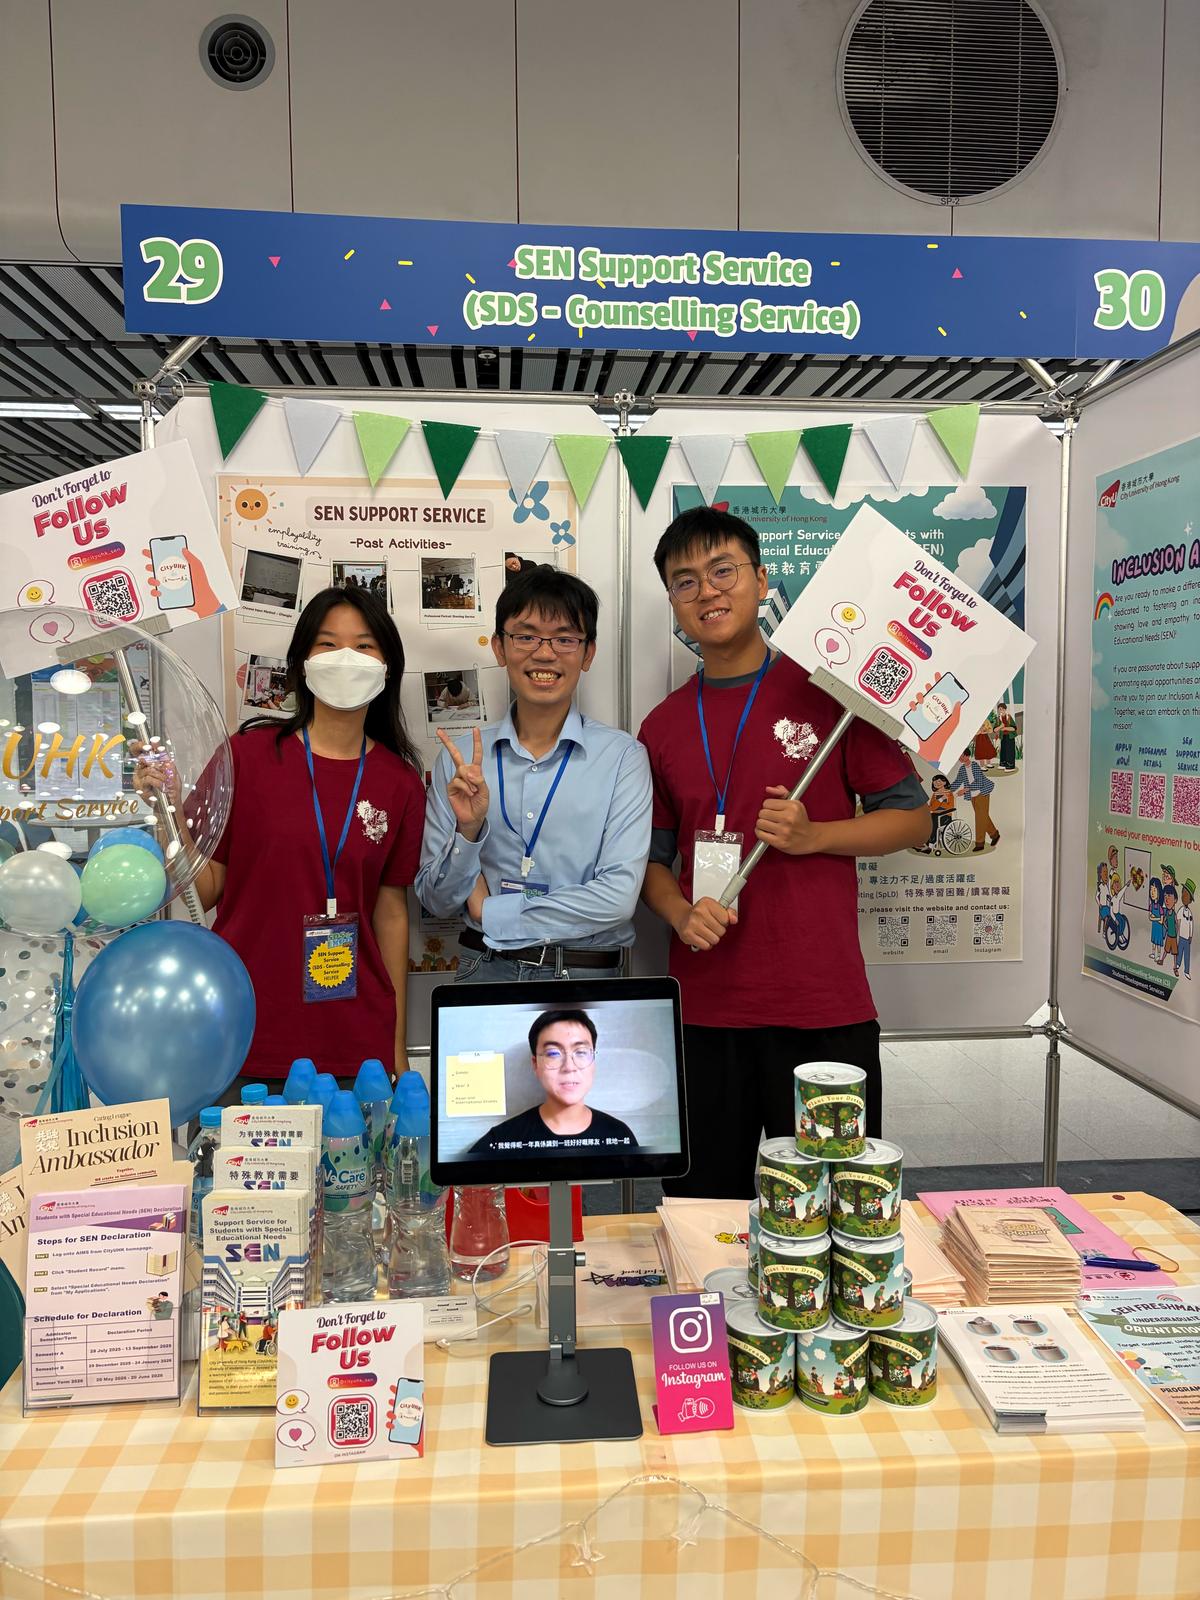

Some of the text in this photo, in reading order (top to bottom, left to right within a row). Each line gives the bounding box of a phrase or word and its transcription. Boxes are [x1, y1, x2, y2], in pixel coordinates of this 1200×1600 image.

[940, 196, 961, 206] SP-2
[139, 236, 224, 304] 29
[513, 244, 813, 287] SEN Support Service
[1092, 267, 1166, 331] 30
[462, 290, 538, 331] (SDS
[564, 293, 738, 337] Counselling
[740, 299, 861, 340] Service)
[31, 469, 113, 509] Don't Forget to
[1128, 486, 1150, 499] University
[33, 481, 129, 538] Follow
[313, 505, 487, 524] SEN SUPPORT SERVICE
[732, 505, 788, 515] 香港城市大學
[747, 514, 828, 525] University of Hong Kong
[72, 518, 111, 546] Us
[268, 527, 323, 547] employability
[796, 529, 841, 541] Service
[920, 528, 945, 540] with
[276, 540, 310, 556] training
[1111, 543, 1187, 586] INCLUSION
[913, 559, 979, 609] Don't Forget to
[892, 571, 978, 632] Follow
[1124, 586, 1176, 603] you ready make
[1113, 600, 1177, 617] dedicated fostering
[908, 606, 942, 637] Us
[1113, 614, 1190, 632] showing love and empathy
[1113, 632, 1161, 646] Educational Needs
[1117, 660, 1184, 674] you are passionate about
[1112, 677, 1194, 690] promoting equal opportunities
[1113, 691, 1194, 703] invite you join our Inclusion
[1113, 707, 1190, 717] Together, can embark on
[1114, 742, 1133, 752] APPLY
[1182, 736, 1193, 746] SEN
[2, 731, 126, 781] UHK
[1138, 746, 1168, 757] PROGRAMME
[1115, 755, 1131, 767] NOW!
[1143, 759, 1162, 768] DETAILS
[1177, 762, 1199, 772] SERVICE
[55, 797, 140, 821] Service
[1104, 824, 1192, 848] We need your engagement to
[868, 873, 976, 885] 專注力不足/過度活躍症
[875, 890, 899, 900] (SpLD)
[869, 906, 894, 914] please
[894, 905, 911, 913] visit
[925, 904, 954, 912] website
[66, 1119, 159, 1148] Inclusion
[28, 1139, 160, 1176] Ambassador
[229, 1170, 300, 1181] 特殊教育需要
[338, 1169, 367, 1185] Care
[334, 1183, 360, 1191] SAFETY
[71, 1211, 91, 1219] Special
[91, 1210, 120, 1218] Educational
[121, 1208, 138, 1216] Needs
[137, 1207, 153, 1215] (SEN)
[153, 1205, 182, 1213] Declaration
[213, 1219, 244, 1227] Support
[246, 1218, 275, 1226] Service
[263, 1225, 293, 1234] Special
[37, 1231, 152, 1247] Steps for SEN Declaration
[215, 1234, 262, 1242] Educational
[225, 1243, 280, 1263] SEN
[781, 1265, 800, 1273] Your
[33, 1309, 143, 1323] Schedule for Declaration
[1111, 1306, 1135, 1316] SEN
[316, 1310, 388, 1329] Don't Forget to
[106, 1328, 136, 1336] Declaration
[310, 1324, 397, 1354] Follow
[339, 1349, 372, 1370] Us
[668, 1360, 718, 1372] FOLLOW US ON
[661, 1370, 727, 1390] Instagram
